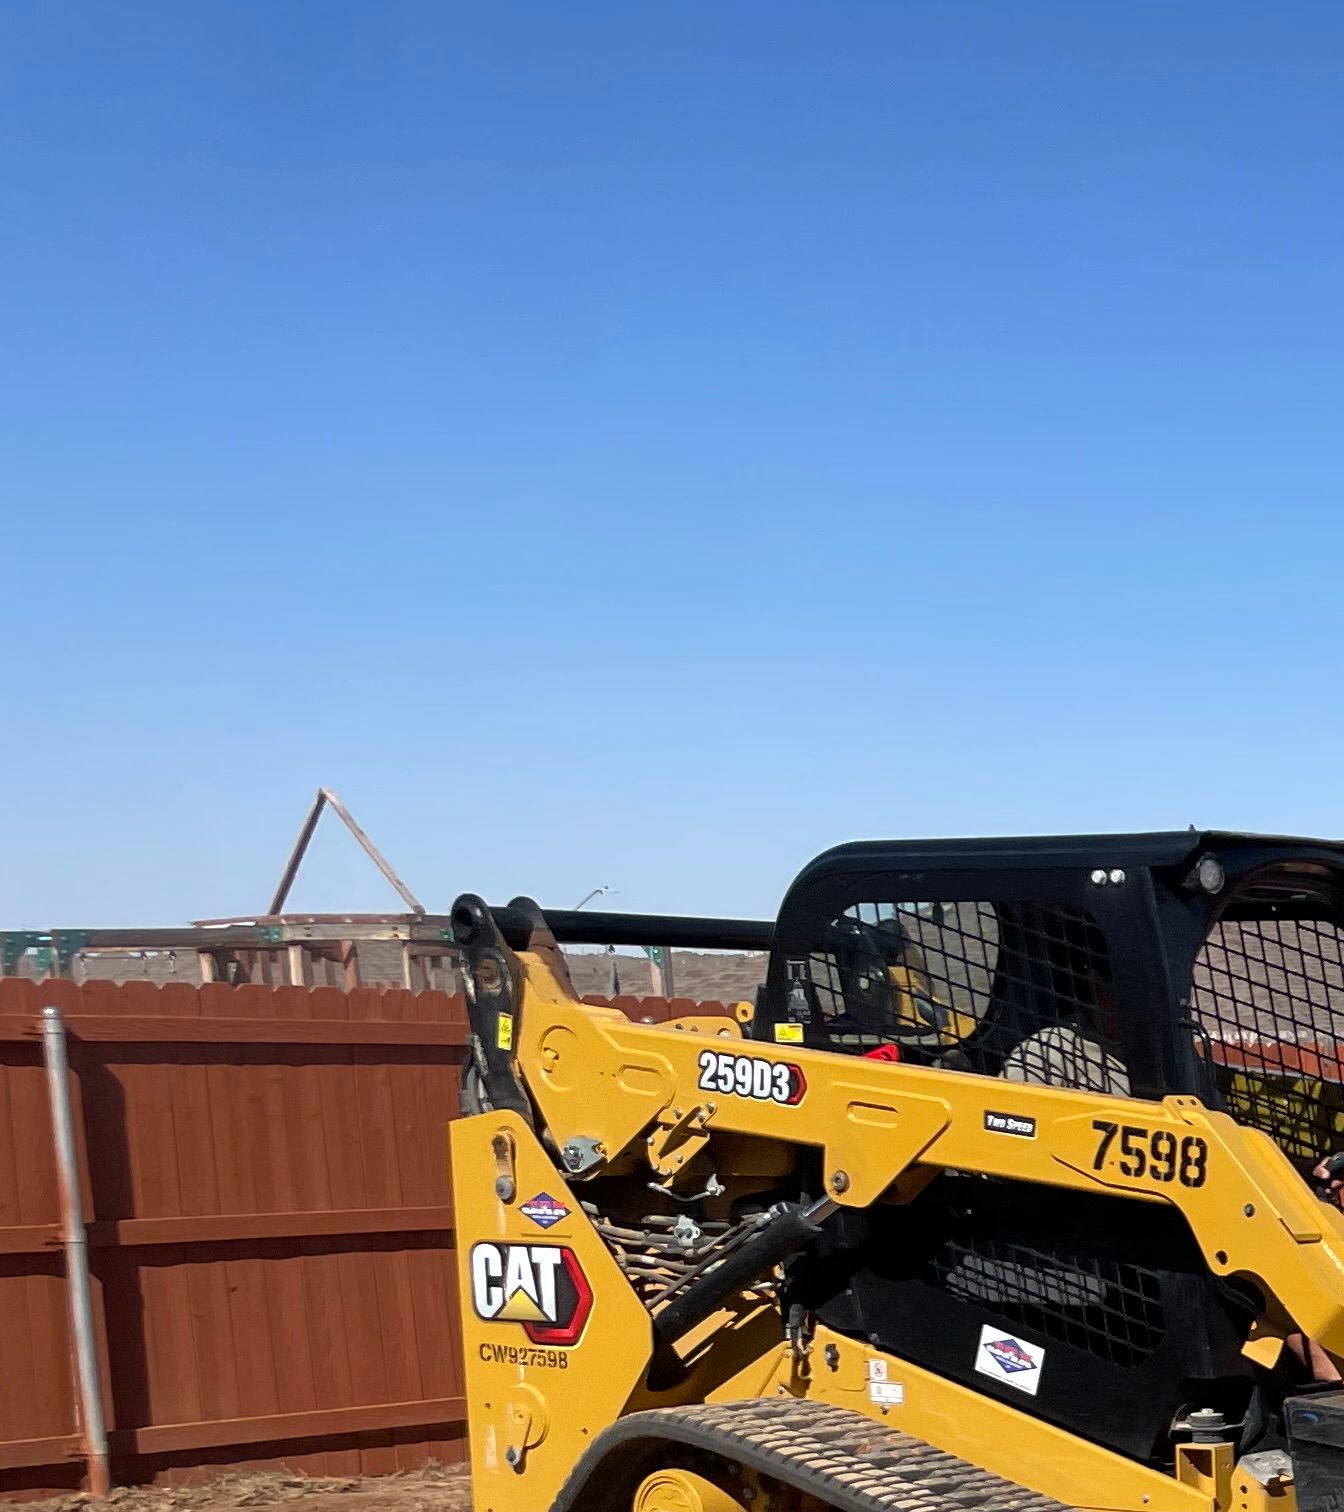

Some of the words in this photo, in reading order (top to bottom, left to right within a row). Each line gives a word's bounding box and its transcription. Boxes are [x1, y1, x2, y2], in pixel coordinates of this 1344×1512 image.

[700, 1051, 790, 1102] 259D3
[1092, 1120, 1208, 1188] 7598
[472, 1243, 562, 1322] CAT
[479, 1343, 568, 1369] CW927598
